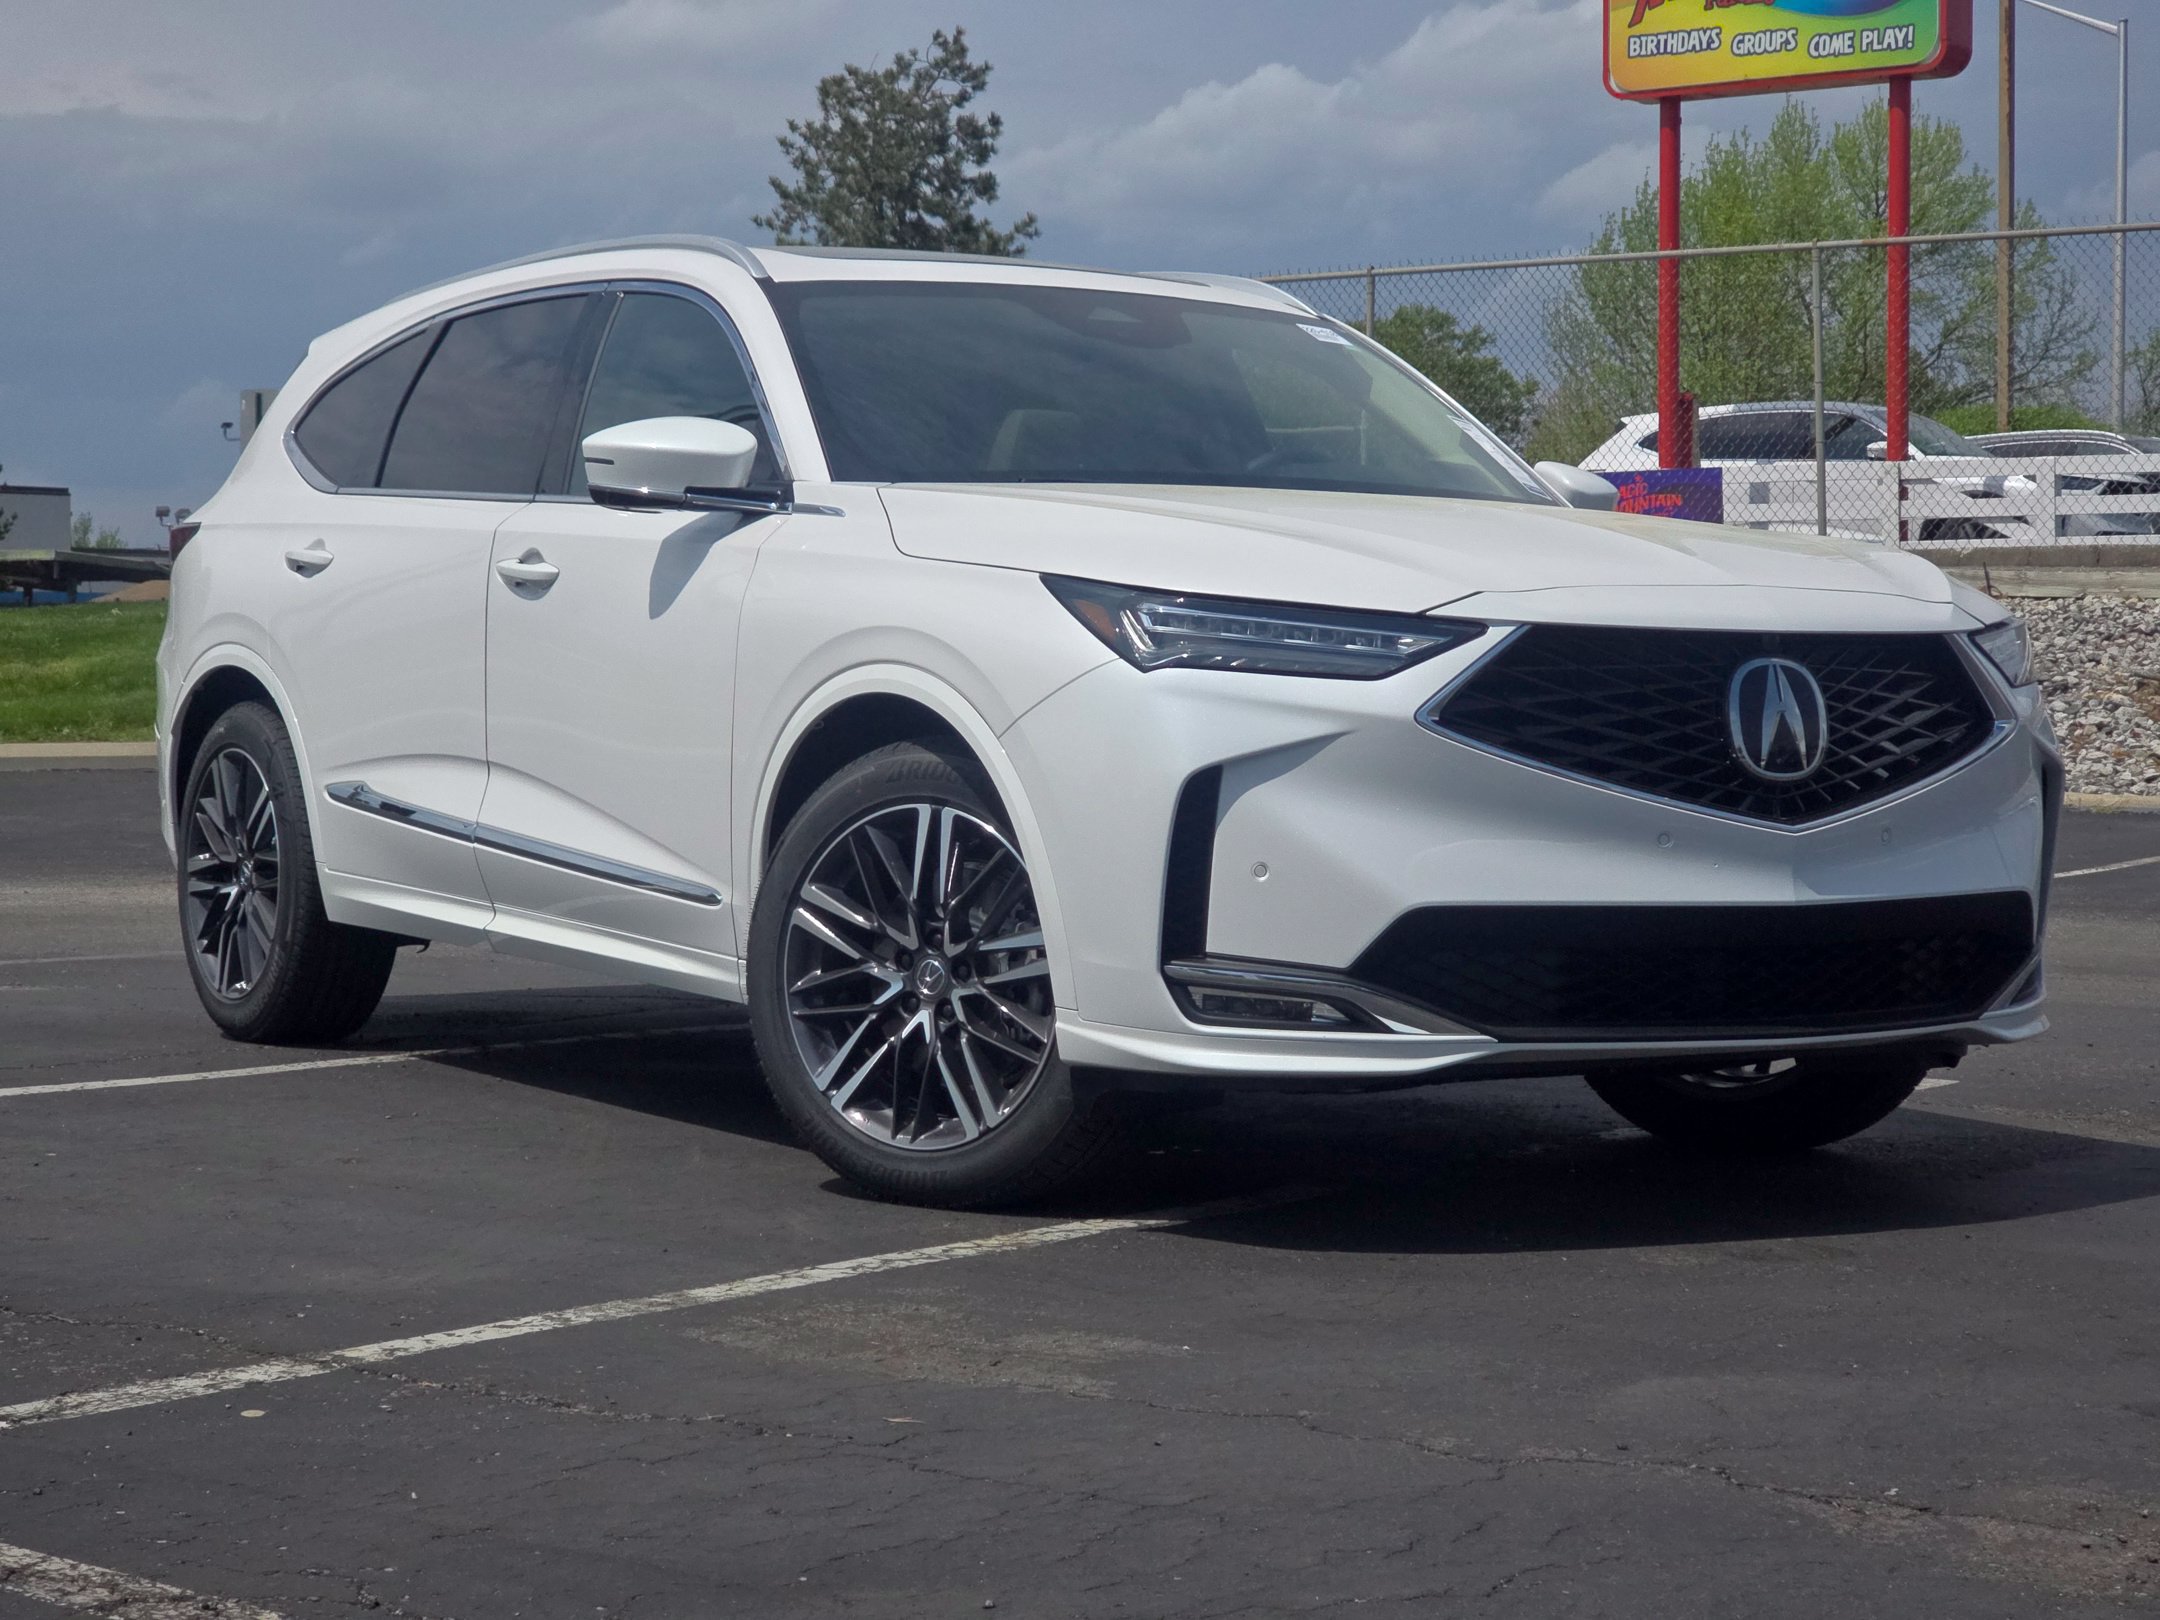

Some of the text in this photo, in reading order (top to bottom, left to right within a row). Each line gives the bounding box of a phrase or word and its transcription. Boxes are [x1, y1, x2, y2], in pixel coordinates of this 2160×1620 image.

[1628, 25, 1914, 57] BIRTHDAYS GROUPS COME PLAY!
[1619, 482, 1648, 498] AGIC
